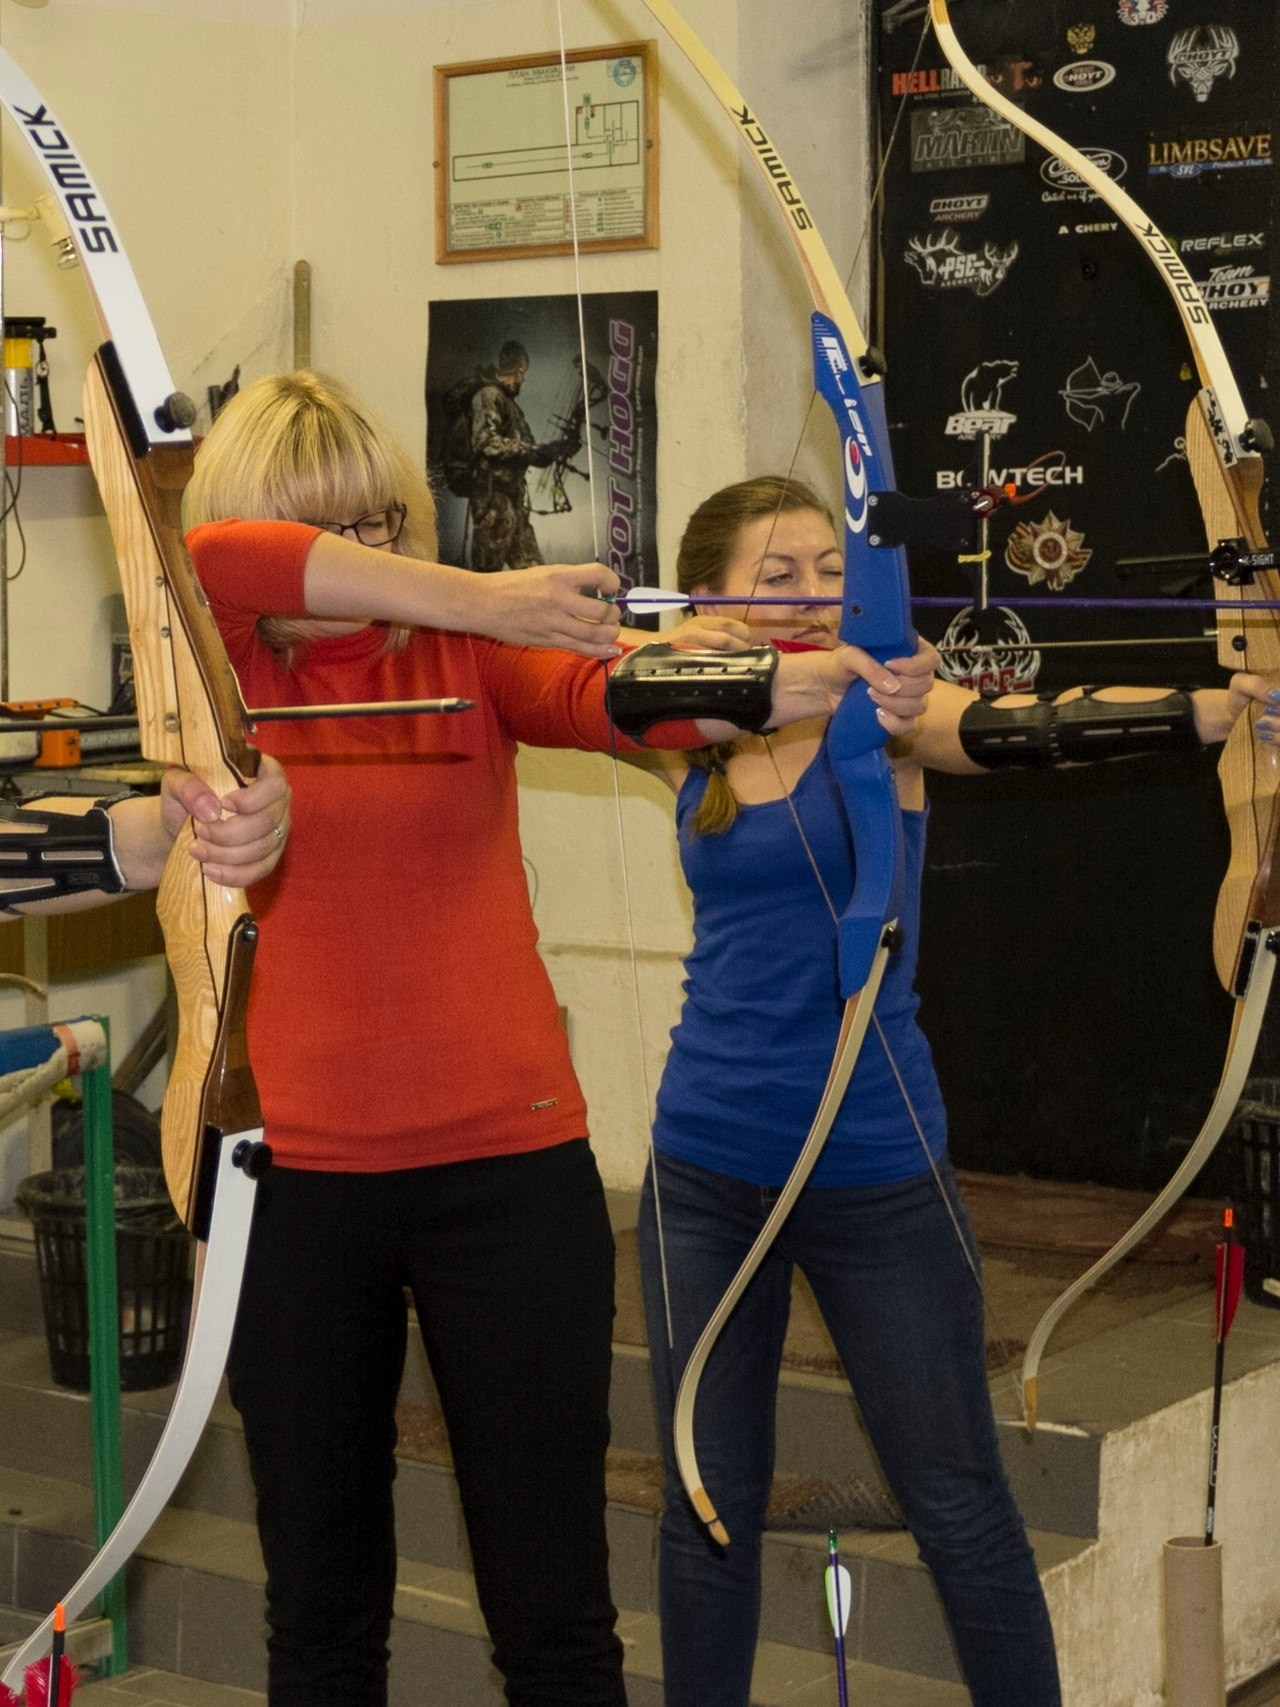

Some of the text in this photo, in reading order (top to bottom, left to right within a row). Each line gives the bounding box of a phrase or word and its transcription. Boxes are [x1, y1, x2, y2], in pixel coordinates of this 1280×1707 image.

[1068, 70, 1104, 81] HOYT
[914, 127, 1021, 161] MARTIN
[1148, 134, 1271, 165] LIMBSAVE
[731, 104, 813, 231] SAMICK
[12, 104, 118, 253] SAMICK
[941, 198, 984, 209] HOYT
[934, 211, 980, 221] ARCHERY
[1181, 233, 1264, 252] REFLEX
[1135, 223, 1209, 324] SAMICK
[1209, 265, 1255, 283] Team
[1208, 298, 1269, 310] RCHERY
[607, 319, 635, 473] HOGG
[944, 415, 1017, 435] Bear
[957, 433, 1002, 441] ARCRY
